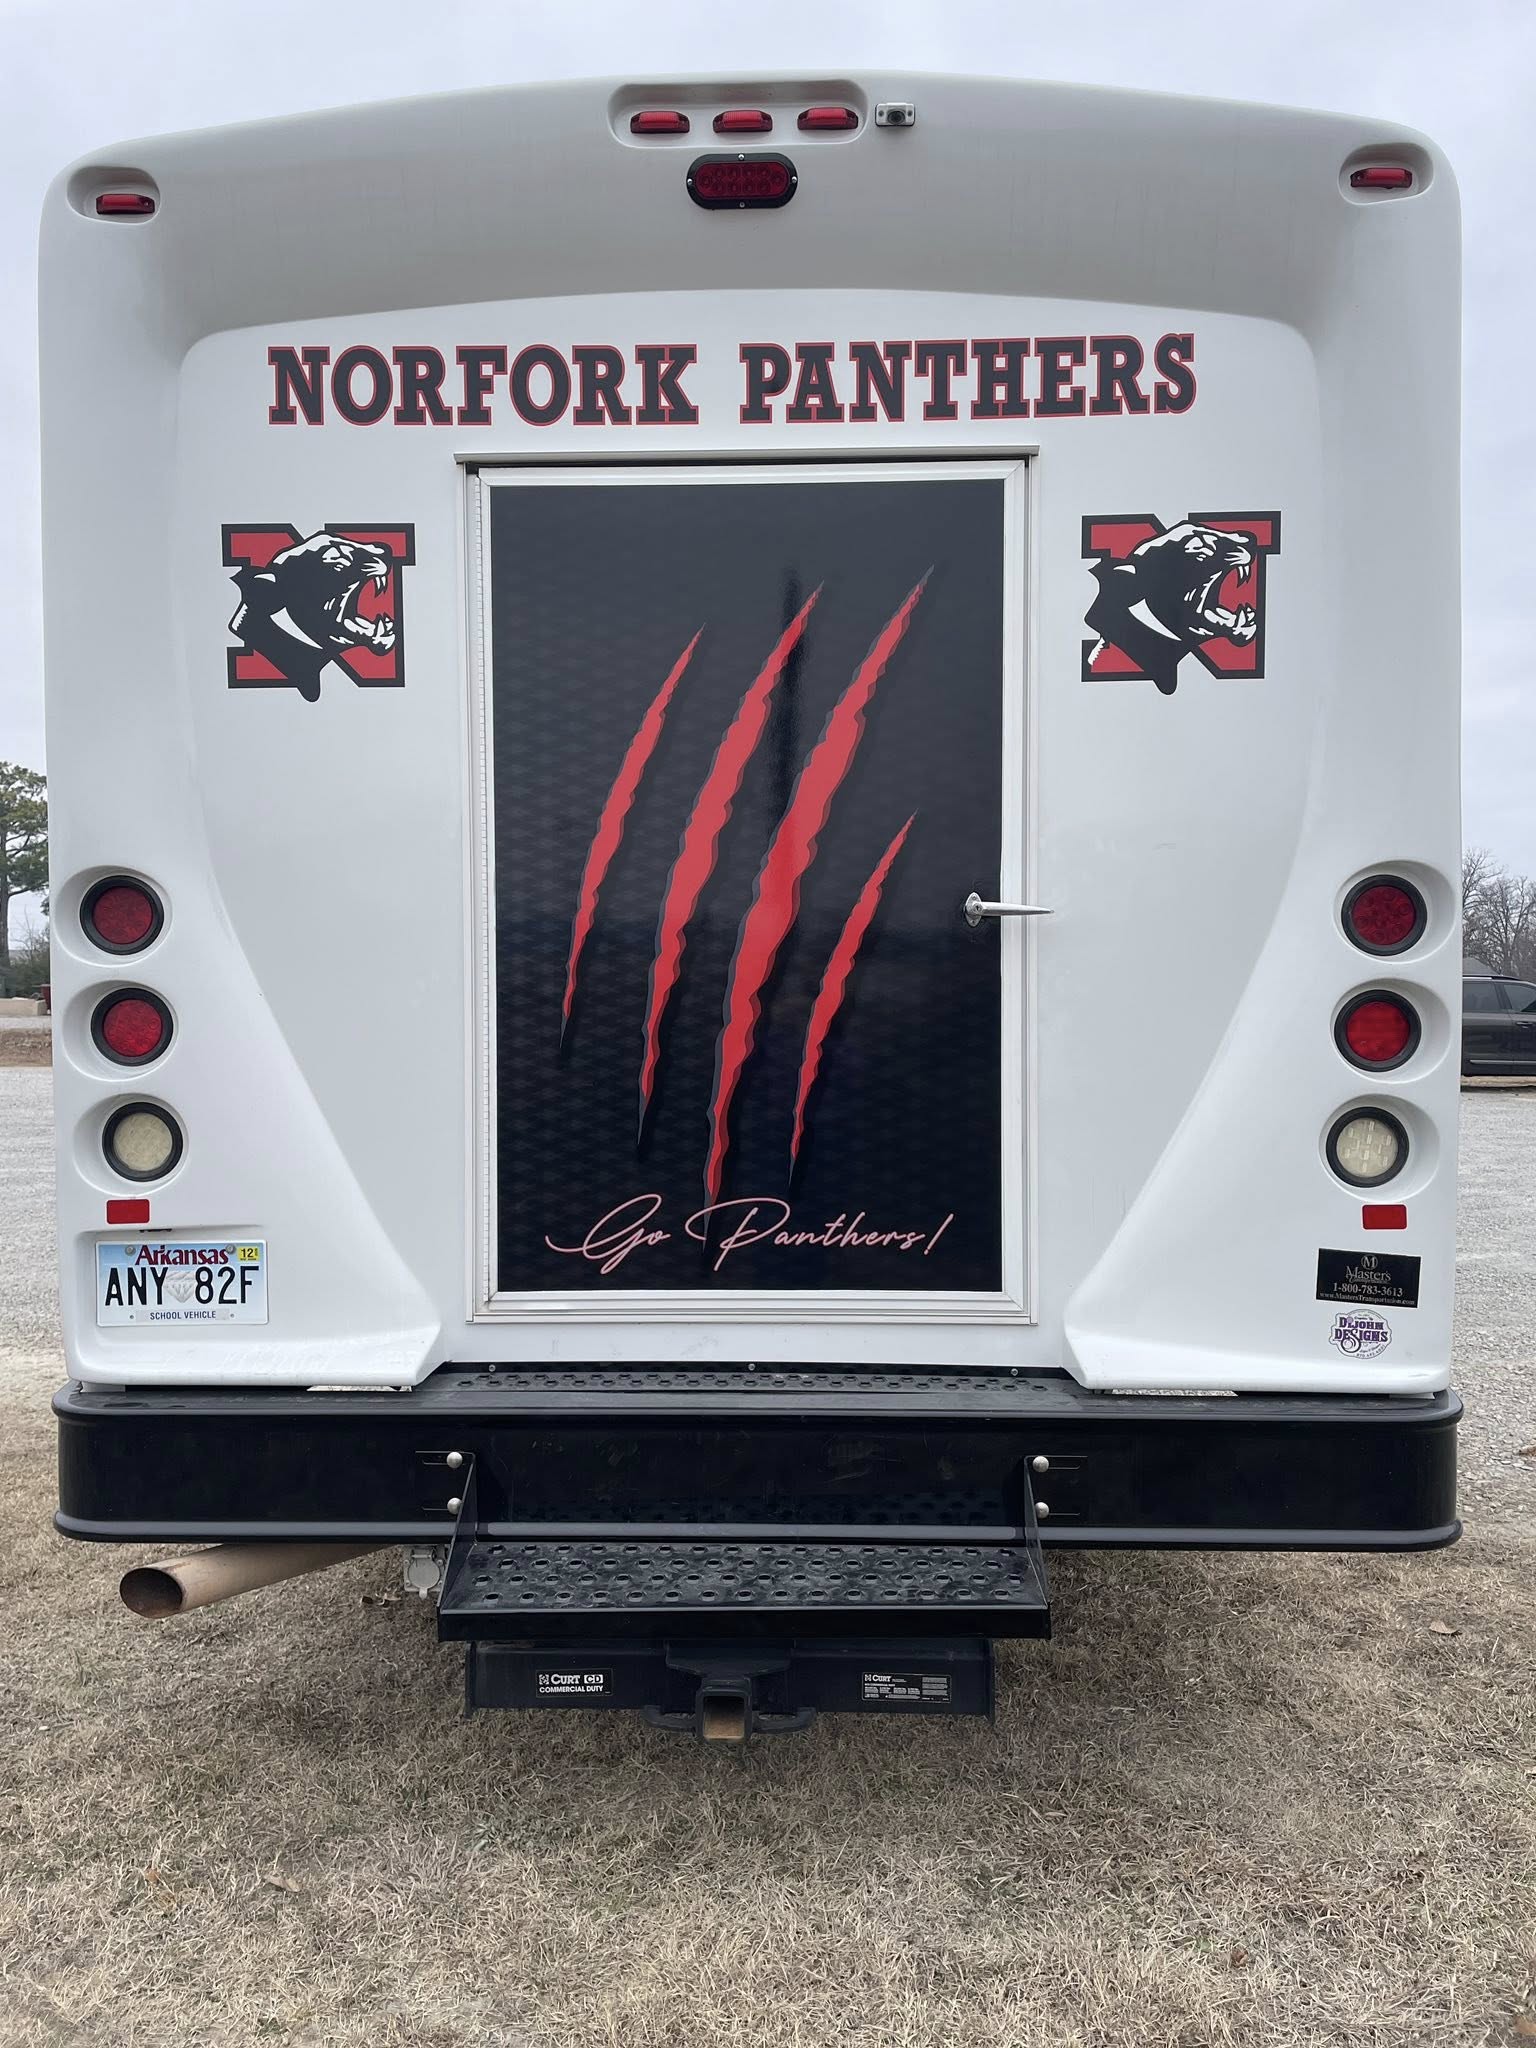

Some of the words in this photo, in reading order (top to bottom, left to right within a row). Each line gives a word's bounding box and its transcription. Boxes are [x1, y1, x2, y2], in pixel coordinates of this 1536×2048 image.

[267, 344, 699, 426] NORFORK
[738, 332, 1198, 424] PANTHERS
[545, 1193, 671, 1275] Go
[685, 1197, 954, 1272] Panthers!
[134, 1244, 229, 1266] Arkansas
[241, 1247, 254, 1258] 12
[105, 1266, 169, 1306] ANY
[194, 1265, 260, 1305] 82F
[1332, 1282, 1404, 1298] 1-800-783-3613
[150, 1312, 181, 1320] SCHOOL
[184, 1311, 216, 1319] VEHICLE
[586, 1675, 602, 1683] CD
[539, 1685, 585, 1693] COMMERCIAL
